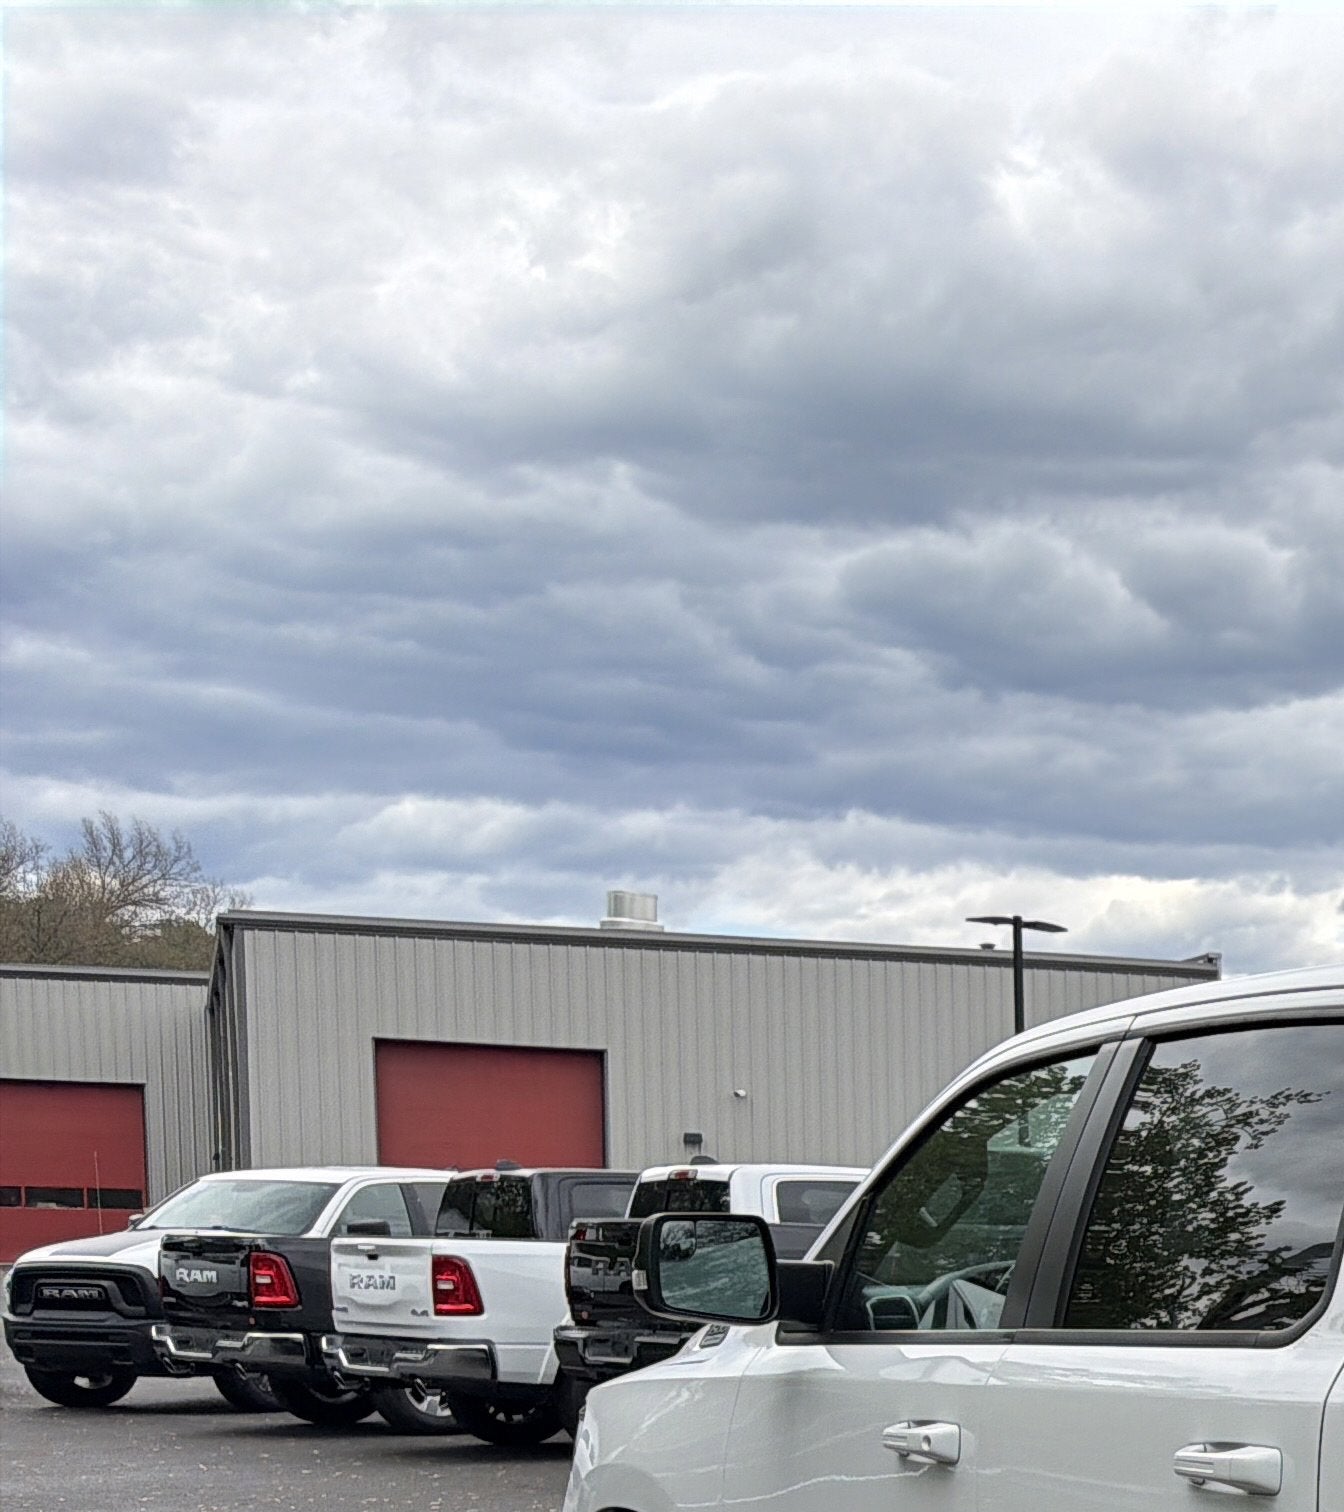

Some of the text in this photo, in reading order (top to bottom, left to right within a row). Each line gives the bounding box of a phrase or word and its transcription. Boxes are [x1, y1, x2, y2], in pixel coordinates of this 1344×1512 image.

[591, 1257, 632, 1276] RA
[175, 1268, 217, 1283] RAM
[349, 1273, 396, 1291] RAM
[42, 1288, 100, 1299] RAM
